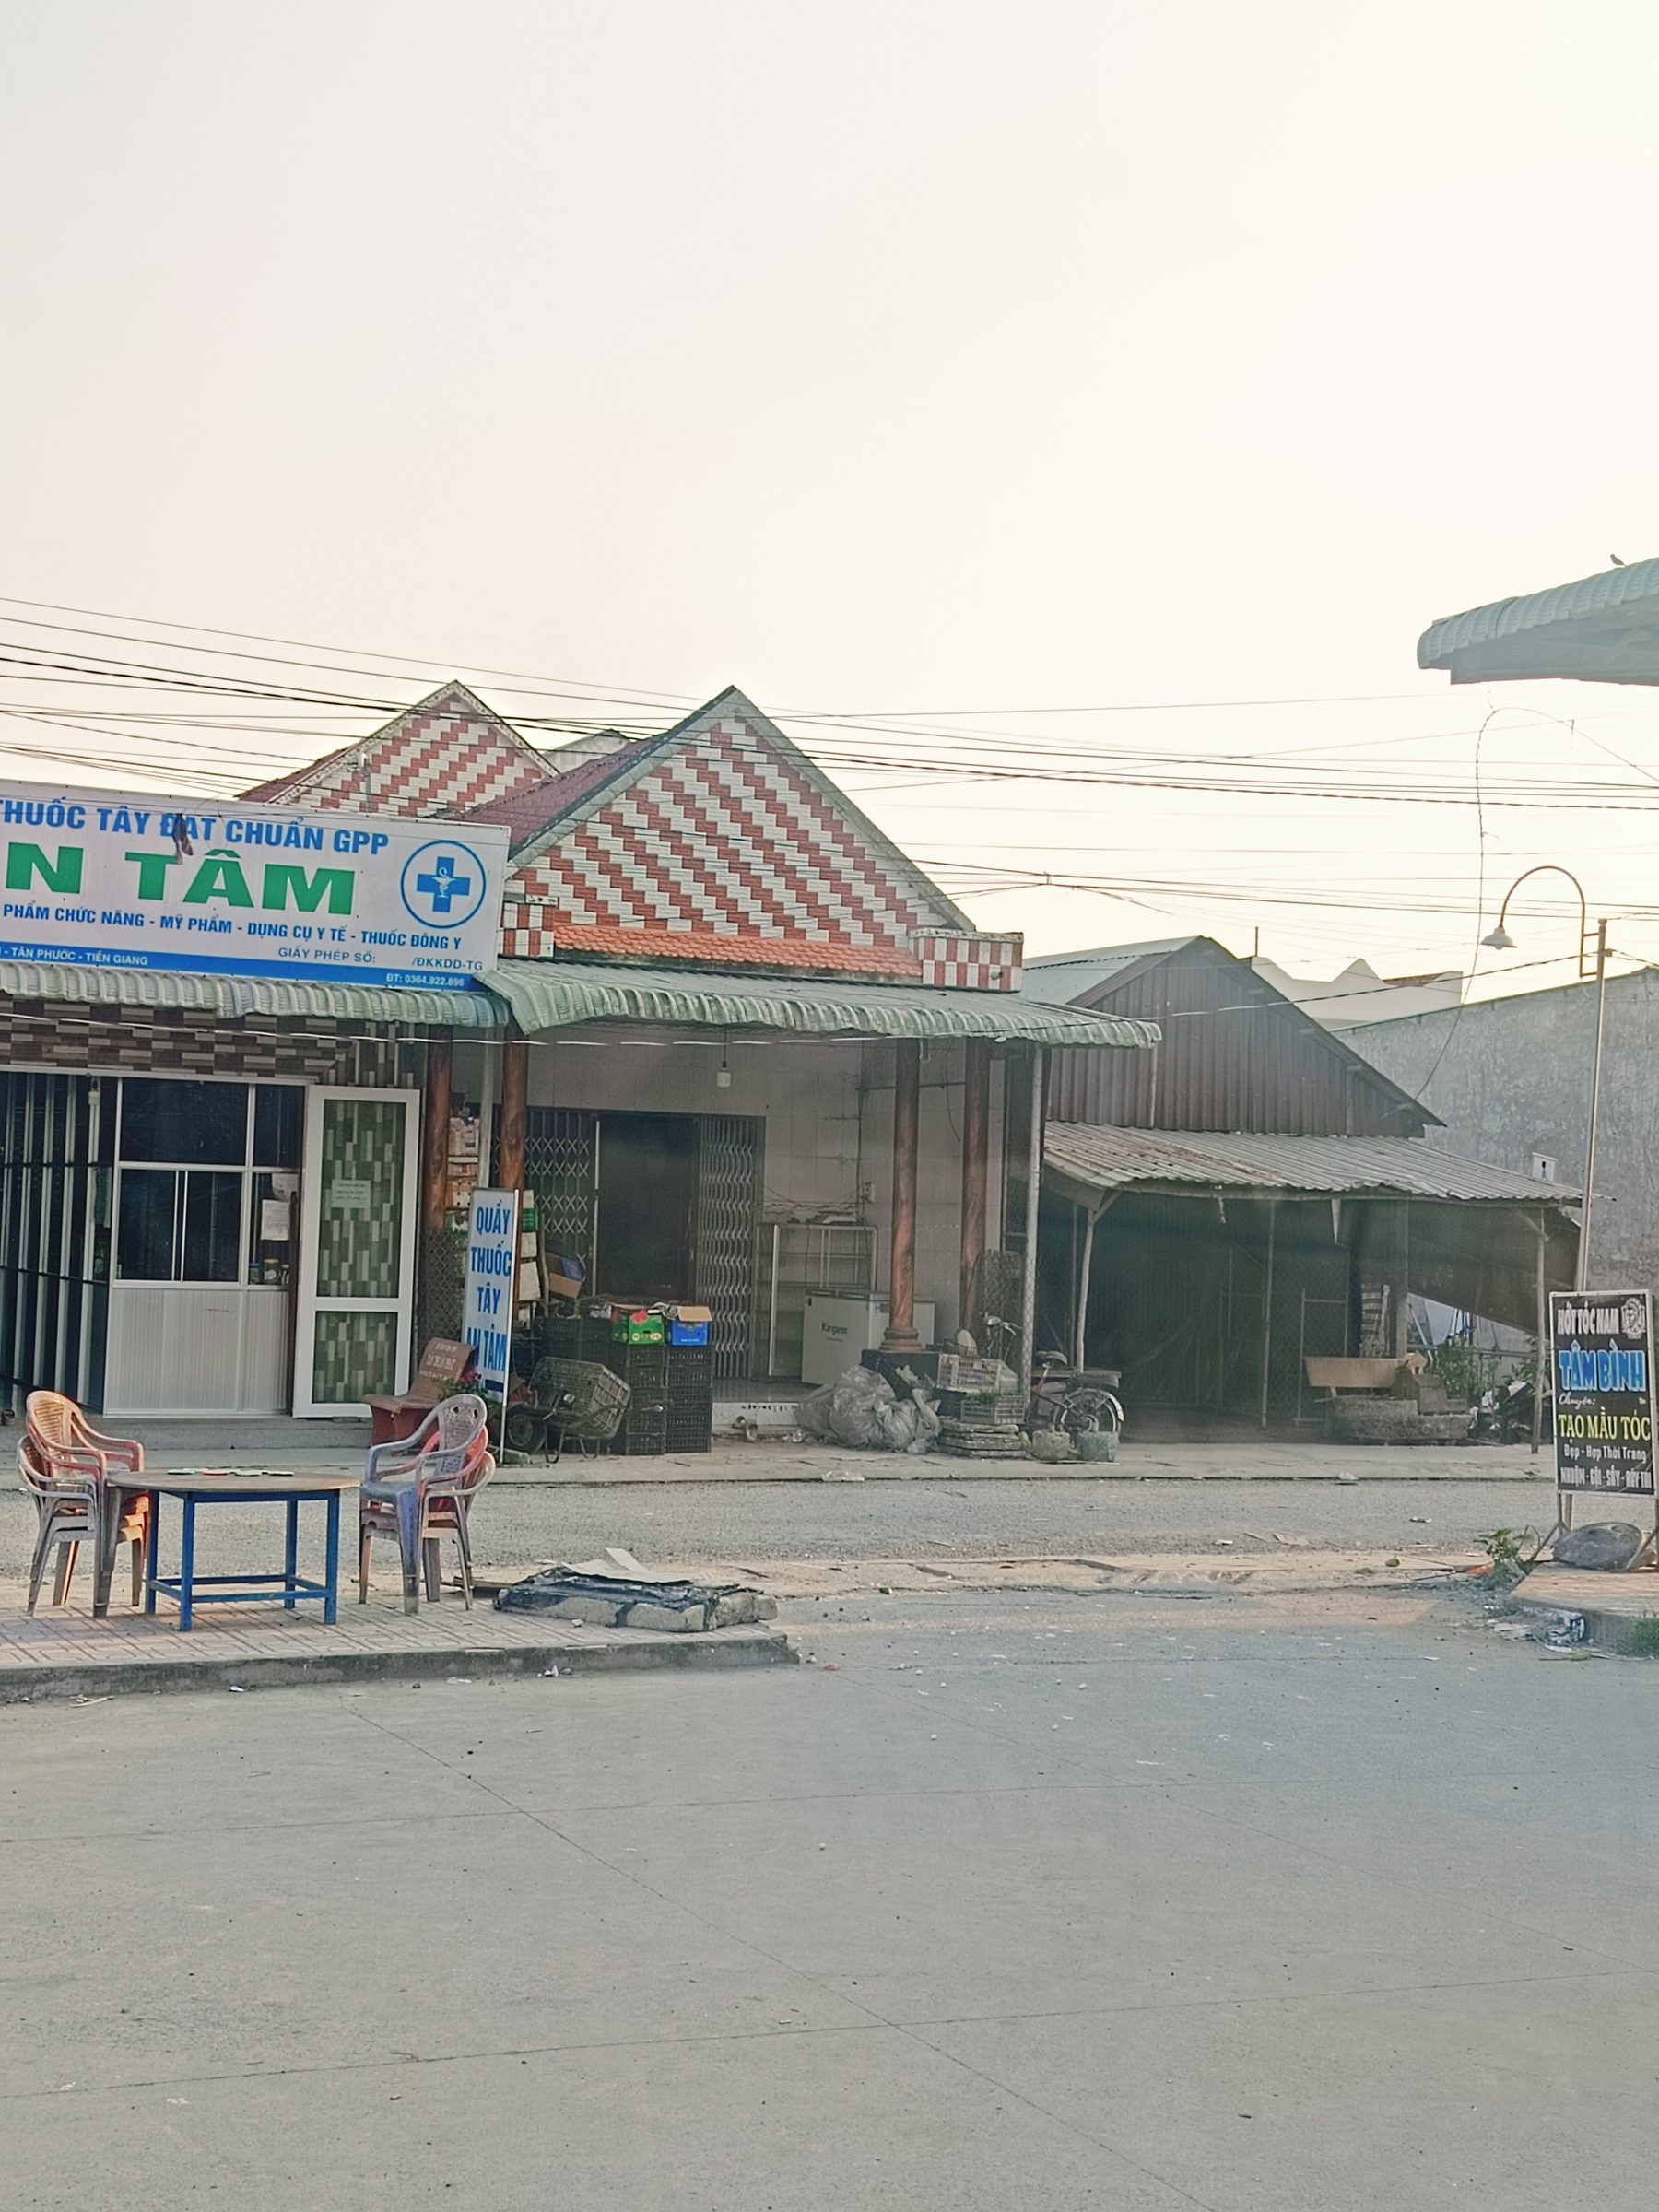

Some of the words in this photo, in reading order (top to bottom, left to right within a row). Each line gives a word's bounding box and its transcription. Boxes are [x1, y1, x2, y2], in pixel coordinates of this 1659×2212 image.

[0, 796, 86, 830] HUỐC
[97, 805, 150, 834] TÂY
[226, 816, 324, 851] CHUẨN
[333, 829, 389, 855] GPP
[124, 848, 355, 915] TÂM
[3, 900, 50, 920] PHẨM
[54, 906, 96, 923] CHỨC
[101, 910, 145, 927] NĂNG
[188, 914, 232, 934] PHẨM
[247, 922, 288, 938] DỤNG
[292, 925, 312, 942] CỤ
[317, 927, 325, 940] Y
[330, 925, 347, 942] TẾ
[360, 928, 406, 947] THUỐC
[410, 932, 449, 949] ĐÔNG
[453, 937, 462, 950] Y
[11, 946, 34, 959] TÂN
[113, 955, 148, 966] GIANG
[278, 945, 310, 959] GIẤY
[314, 949, 350, 961] PHÉP
[386, 972, 403, 983] ĐT:
[471, 1240, 512, 1277] THUỐC
[477, 1282, 500, 1315] TÂY
[1578, 1300, 1595, 1335] TÓC
[1596, 1307, 1619, 1335] NAM
[484, 1323, 507, 1371] TÂM
[1559, 1339, 1597, 1391] TÂM
[1597, 1338, 1646, 1392] BÌNH
[1558, 1414, 1584, 1443] TẠO
[1620, 1409, 1651, 1441] TÓC
[1622, 1446, 1646, 1464] Trang
